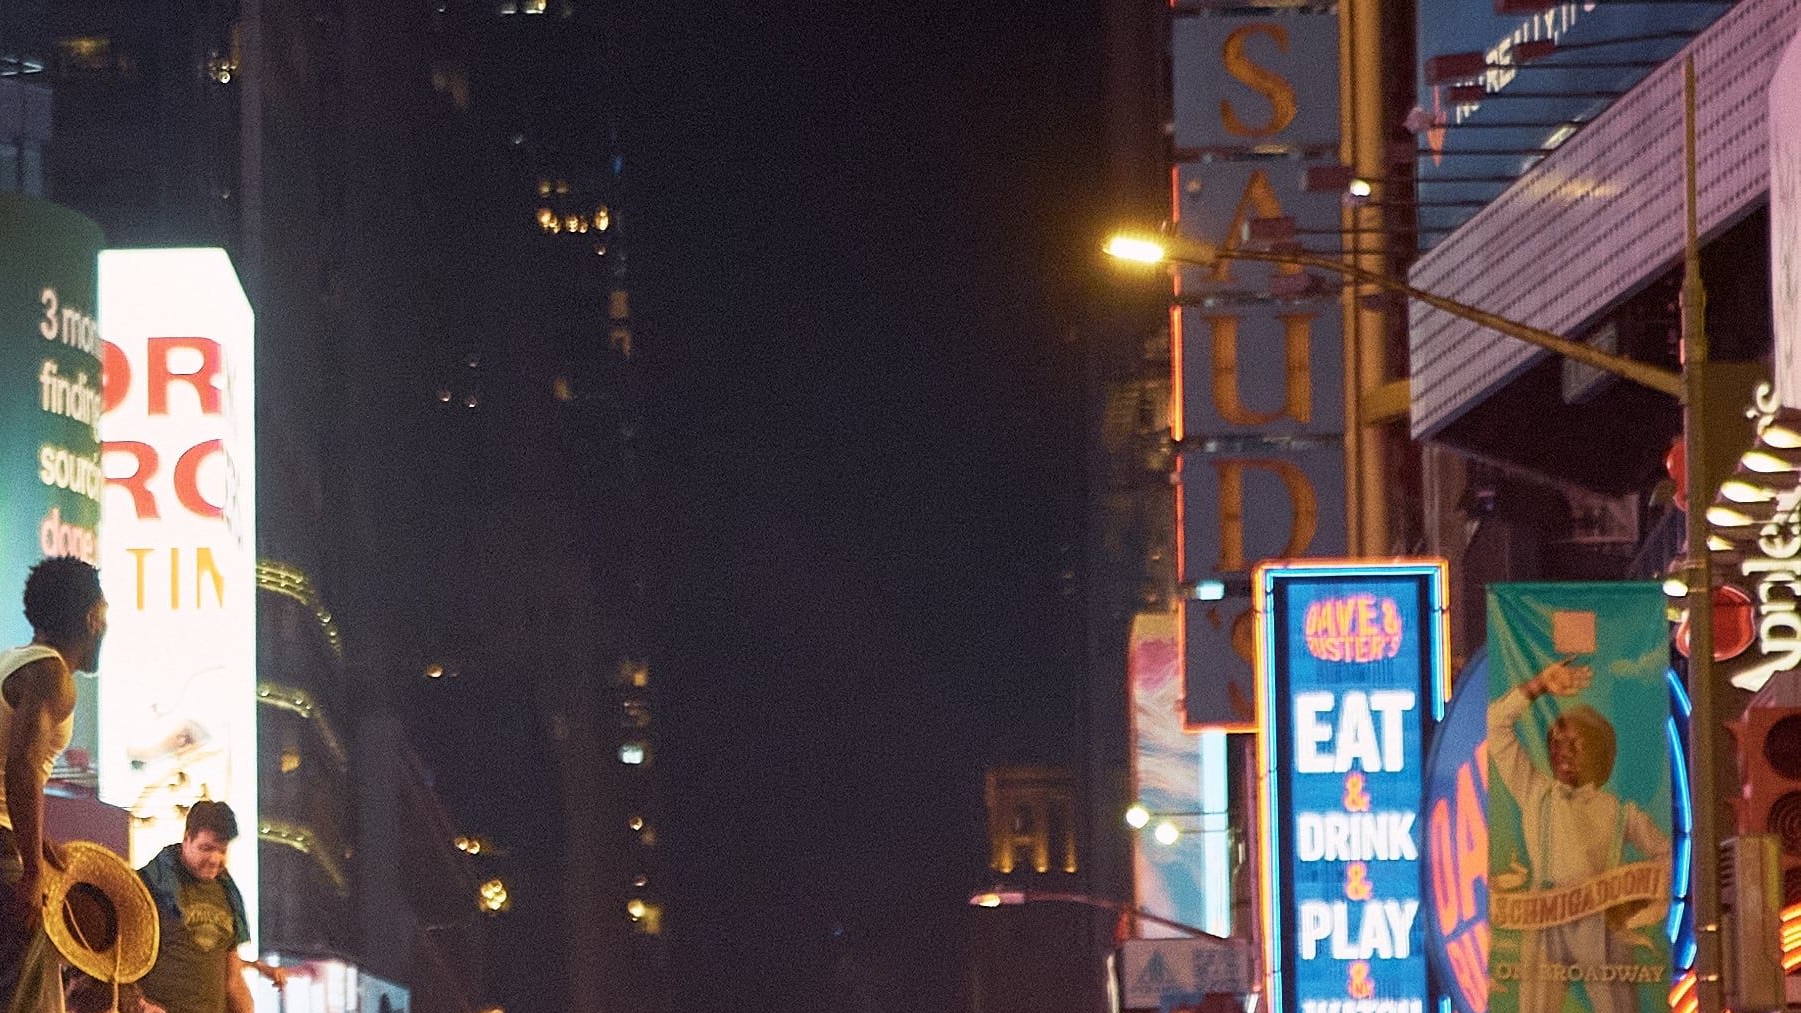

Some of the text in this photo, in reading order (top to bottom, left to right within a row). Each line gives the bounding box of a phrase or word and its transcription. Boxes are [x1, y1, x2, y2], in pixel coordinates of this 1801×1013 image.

[40, 287, 58, 341] 3
[1296, 690, 1415, 773] EAT
[1344, 772, 1370, 812] &
[1298, 813, 1418, 862] DRINK
[1346, 861, 1372, 901] &
[1301, 901, 1419, 960] PLAY
[1348, 960, 1375, 999] &
[1539, 961, 1665, 983] BROADWAY
